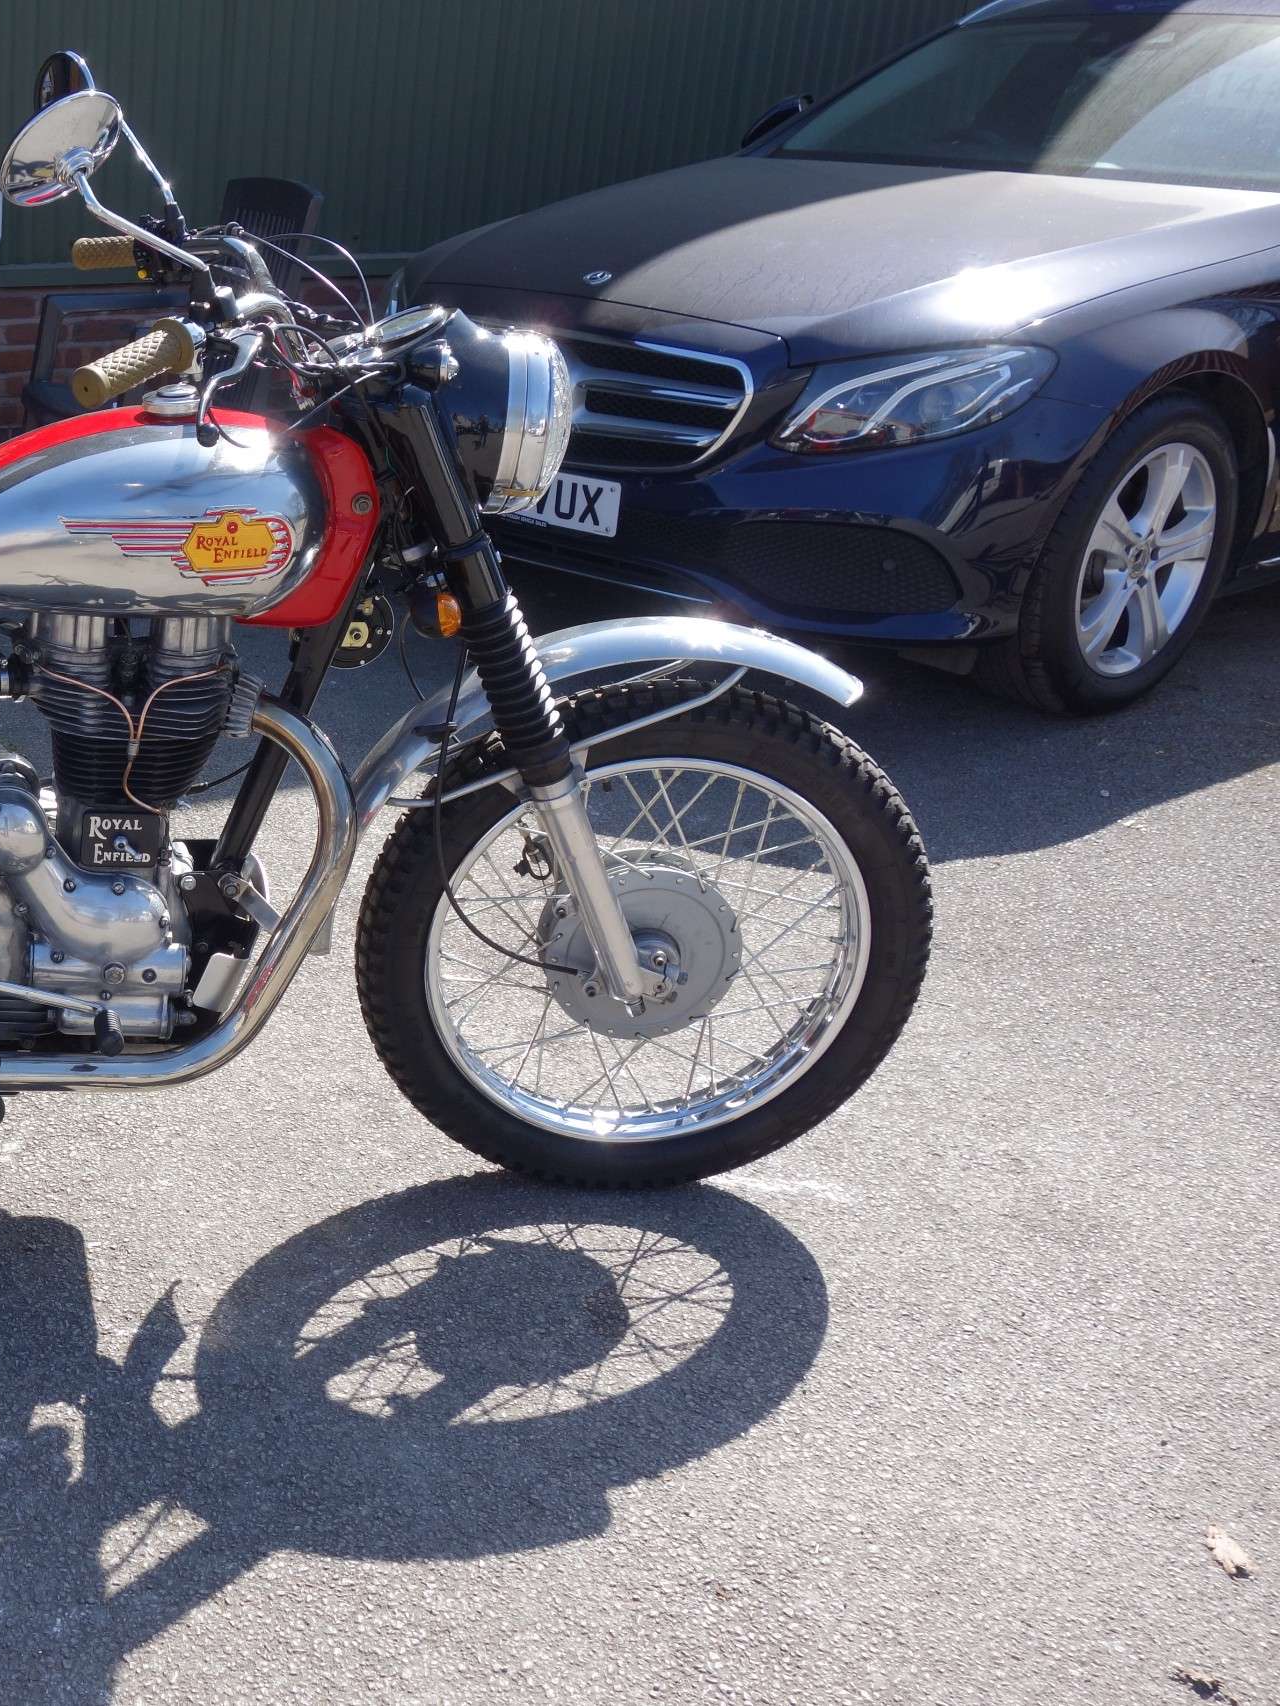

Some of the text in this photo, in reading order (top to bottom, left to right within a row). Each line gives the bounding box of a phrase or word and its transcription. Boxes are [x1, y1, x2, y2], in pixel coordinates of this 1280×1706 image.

[195, 535, 238, 551] ROYAL
[213, 547, 268, 563] ENFIELD
[89, 816, 143, 840] ROYAL
[93, 842, 151, 864] ENFIED
